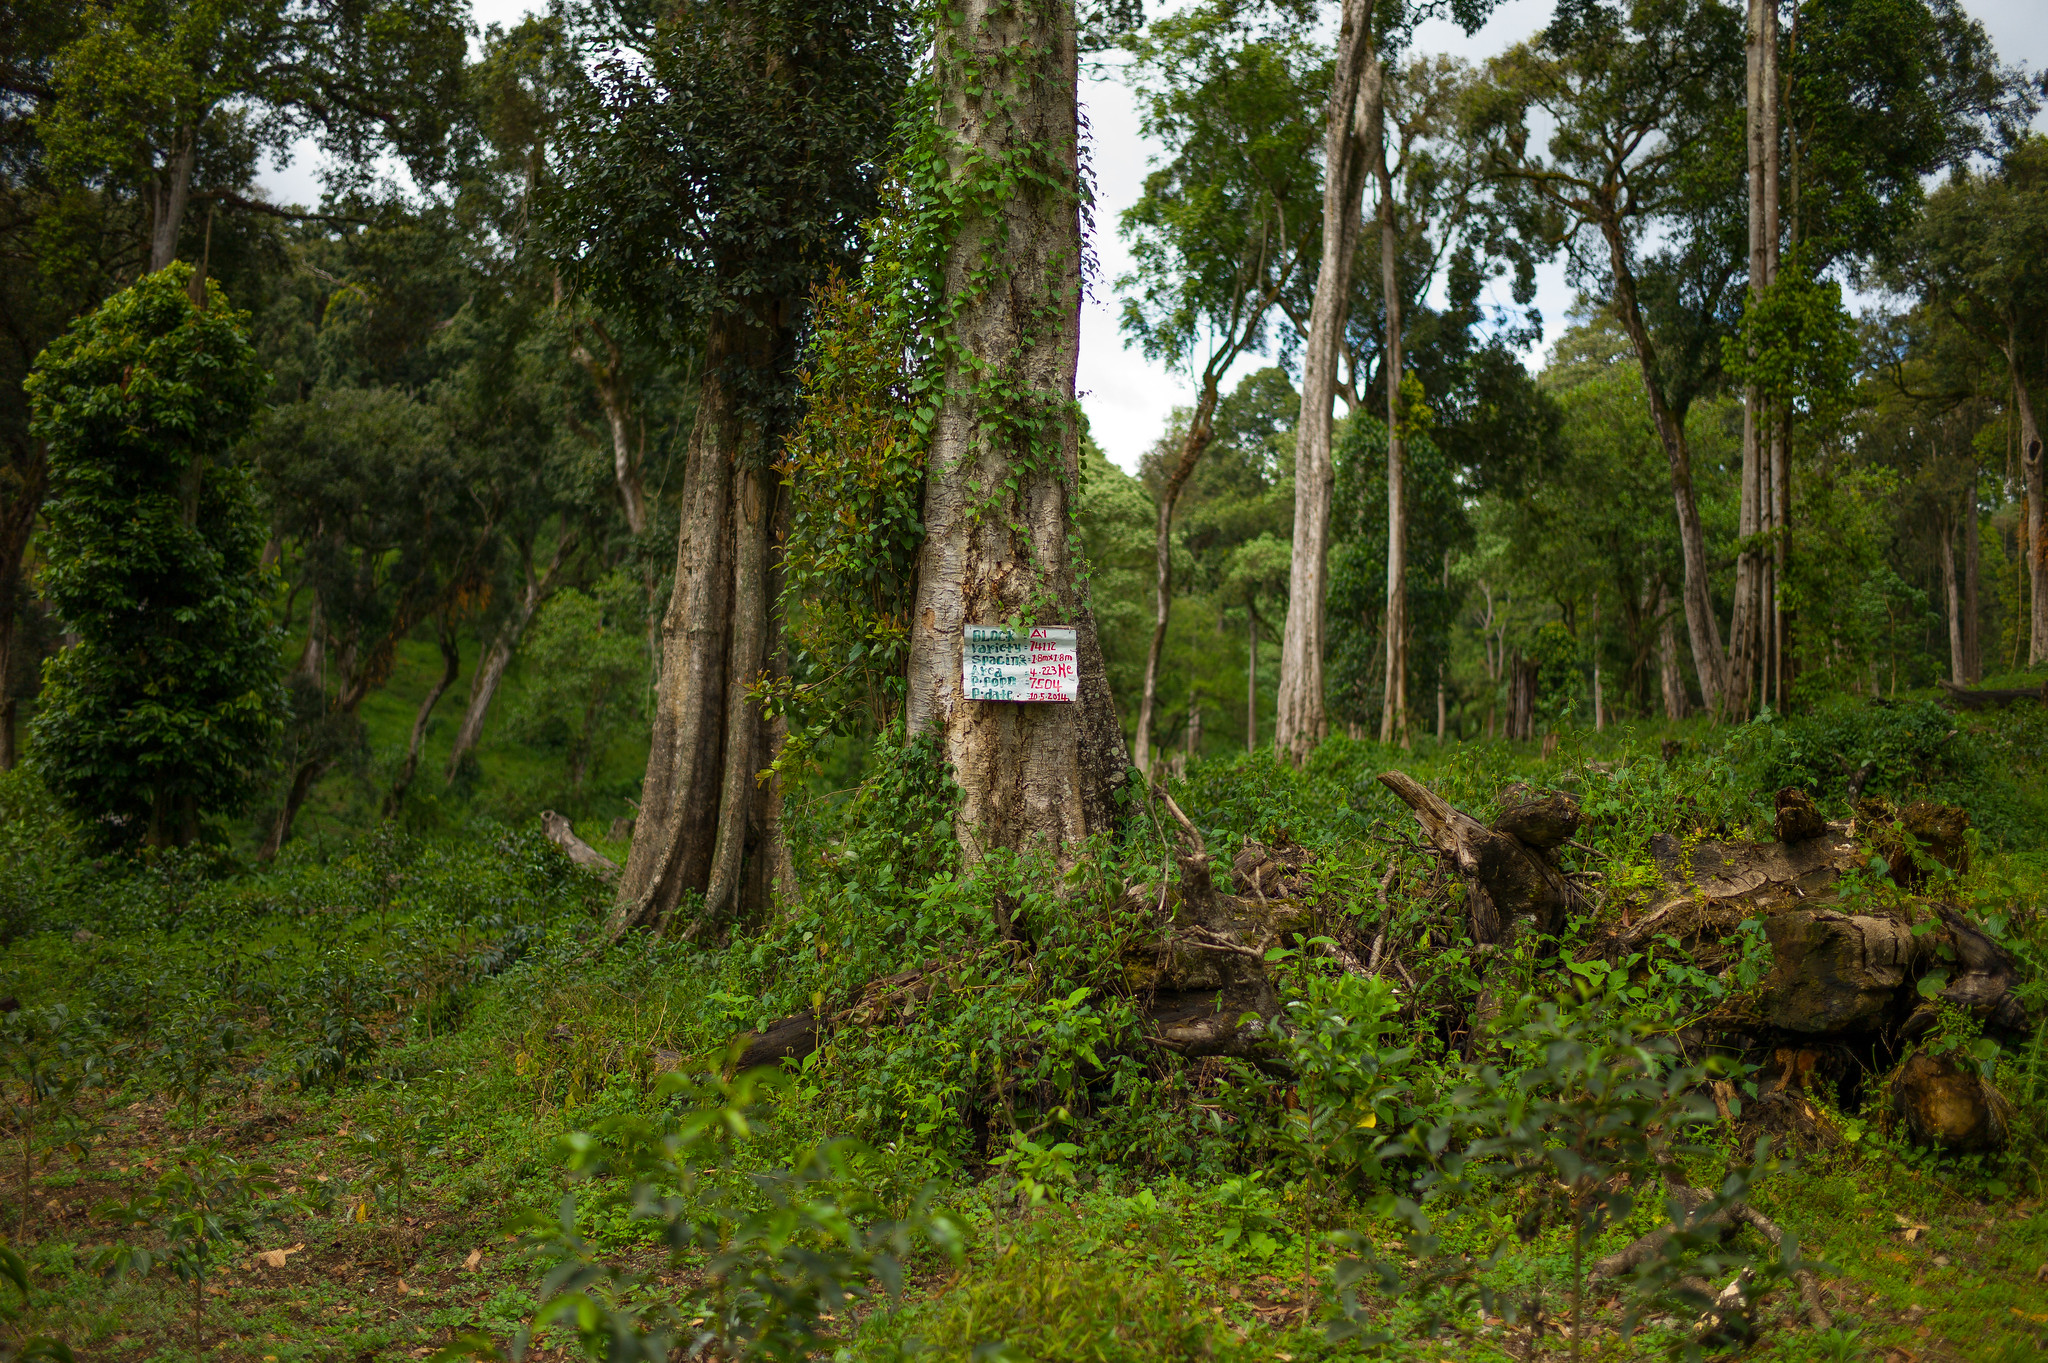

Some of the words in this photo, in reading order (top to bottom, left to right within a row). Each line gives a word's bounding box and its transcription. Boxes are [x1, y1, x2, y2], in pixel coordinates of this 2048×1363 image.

[973, 630, 1015, 642] BLOCK
[1030, 640, 1056, 652] 74112
[970, 665, 1003, 677] Area
[1030, 666, 1057, 677] 4.223
[1029, 677, 1062, 692] 7504
